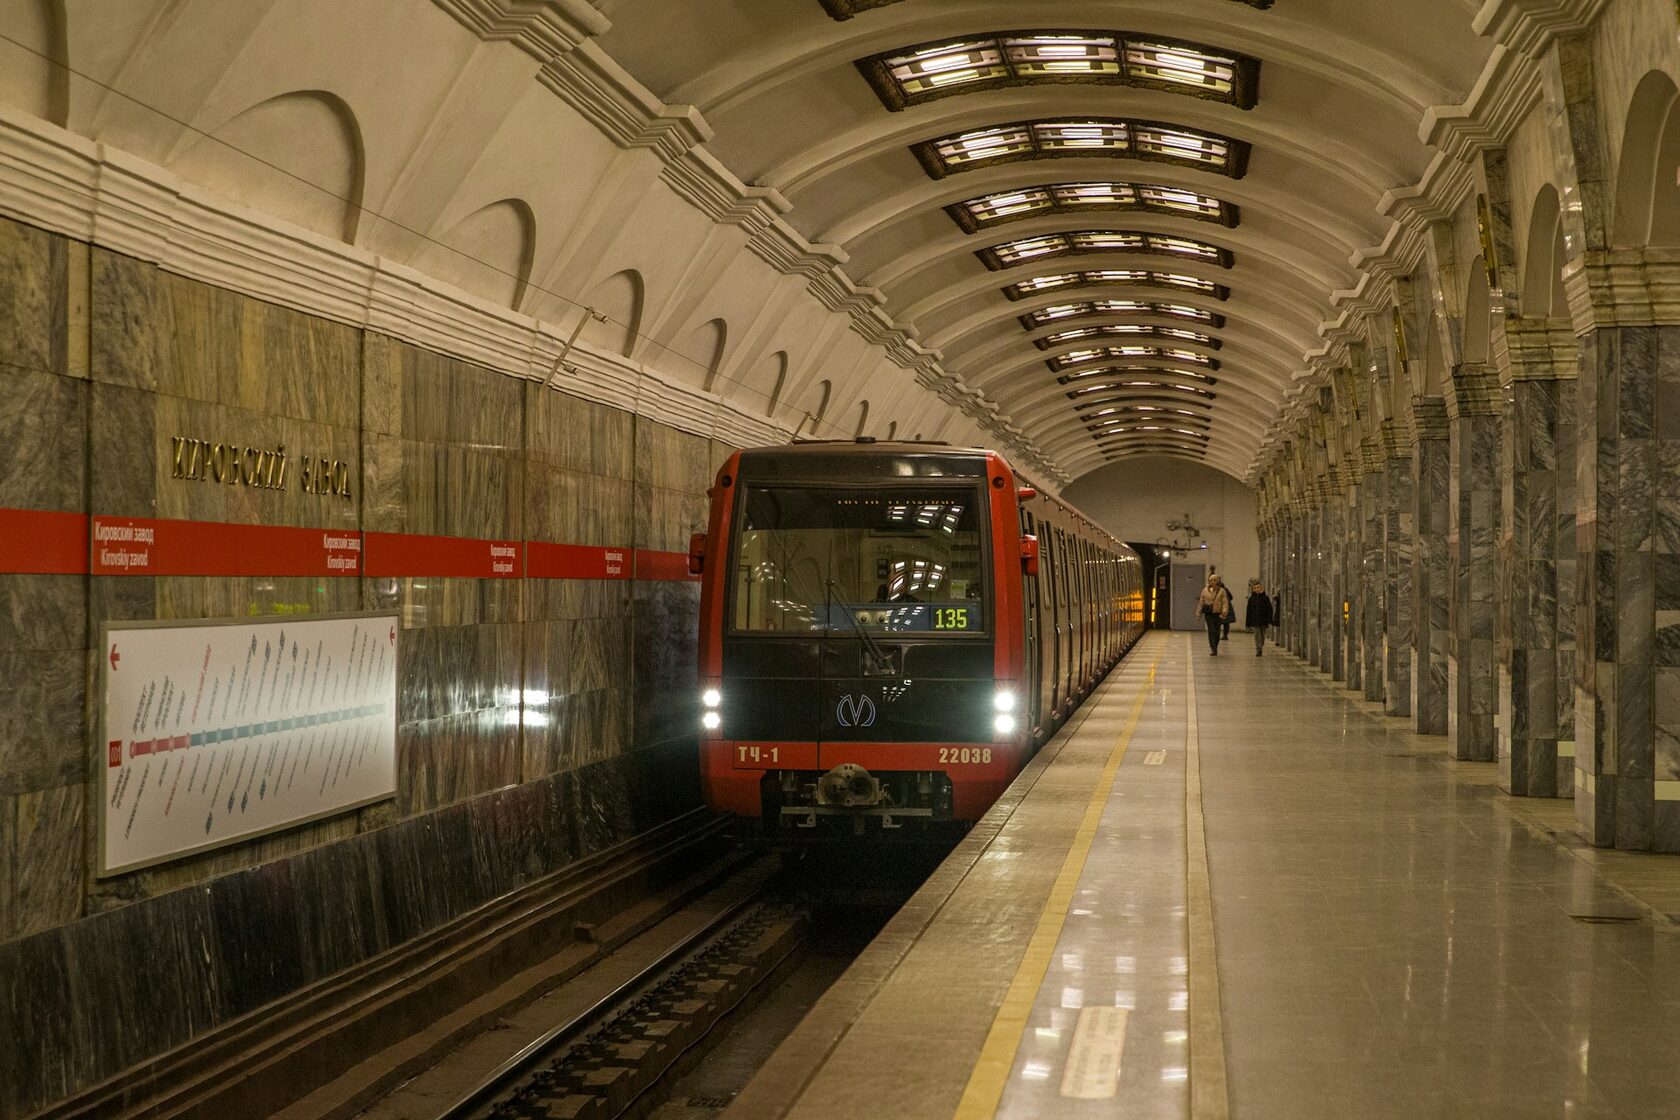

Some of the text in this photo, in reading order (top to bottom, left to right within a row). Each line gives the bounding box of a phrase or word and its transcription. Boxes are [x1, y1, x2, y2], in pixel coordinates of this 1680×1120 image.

[172, 436, 351, 497] КИРОВСКИЙ ЗАВОД
[95, 521, 154, 546] Кировский завод
[101, 548, 148, 570] Kirovskiy zavod
[935, 608, 967, 629] 135
[939, 747, 992, 764] 22038
